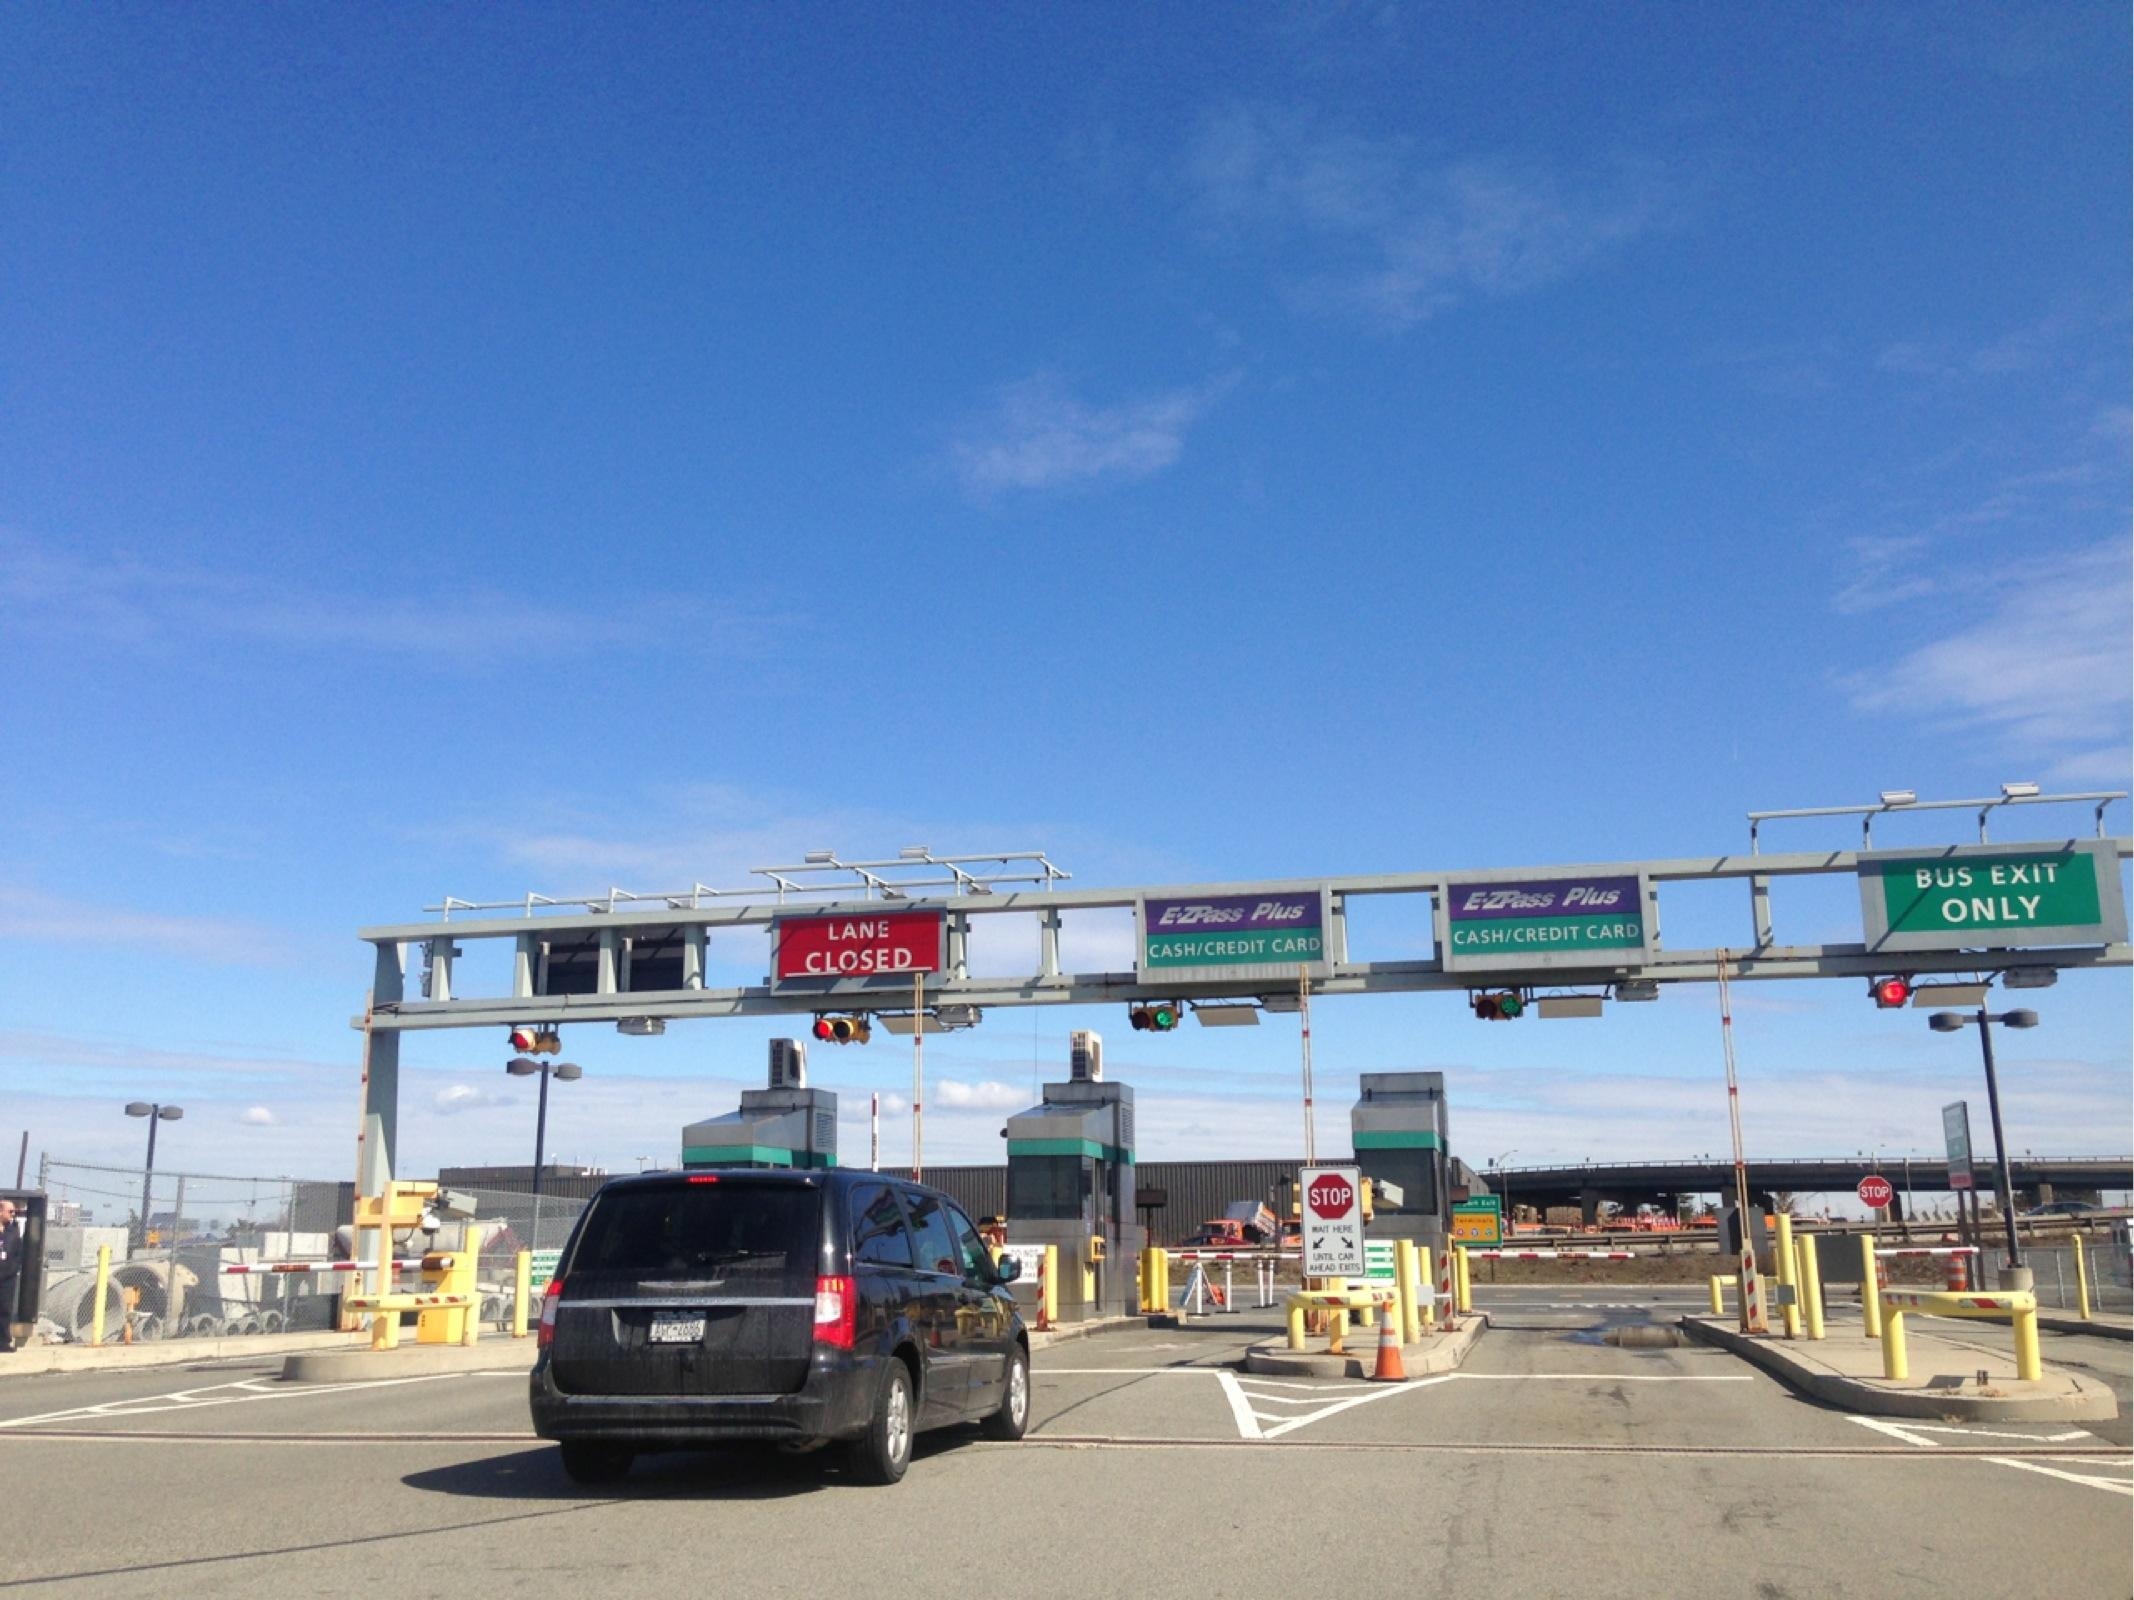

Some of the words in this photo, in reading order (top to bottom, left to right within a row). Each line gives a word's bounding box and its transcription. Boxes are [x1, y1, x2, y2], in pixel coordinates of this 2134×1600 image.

[1916, 866, 1973, 889] BUS
[1990, 863, 2058, 885] EXIT
[1562, 887, 1620, 907] Plus
[1251, 902, 1305, 921] Plus
[1941, 895, 2041, 923] ONLY
[828, 920, 889, 941] LANE
[1454, 926, 1579, 945] CASH/CREDIT
[1587, 923, 1639, 939] CARD
[1149, 939, 1265, 958] CASH/CREDIT
[1272, 937, 1321, 953] CARD
[805, 947, 912, 973] CLOSED
[1311, 1187, 1351, 1206] STOP
[1861, 1186, 1889, 1198] STOP
[1311, 1224, 1329, 1233] WAIT
[1333, 1224, 1353, 1233] HERE
[1312, 1252, 1333, 1261] UNTIL
[1338, 1252, 1354, 1261] CAR
[1309, 1263, 1336, 1272] AHEAD
[1340, 1263, 1360, 1272] EXITS
